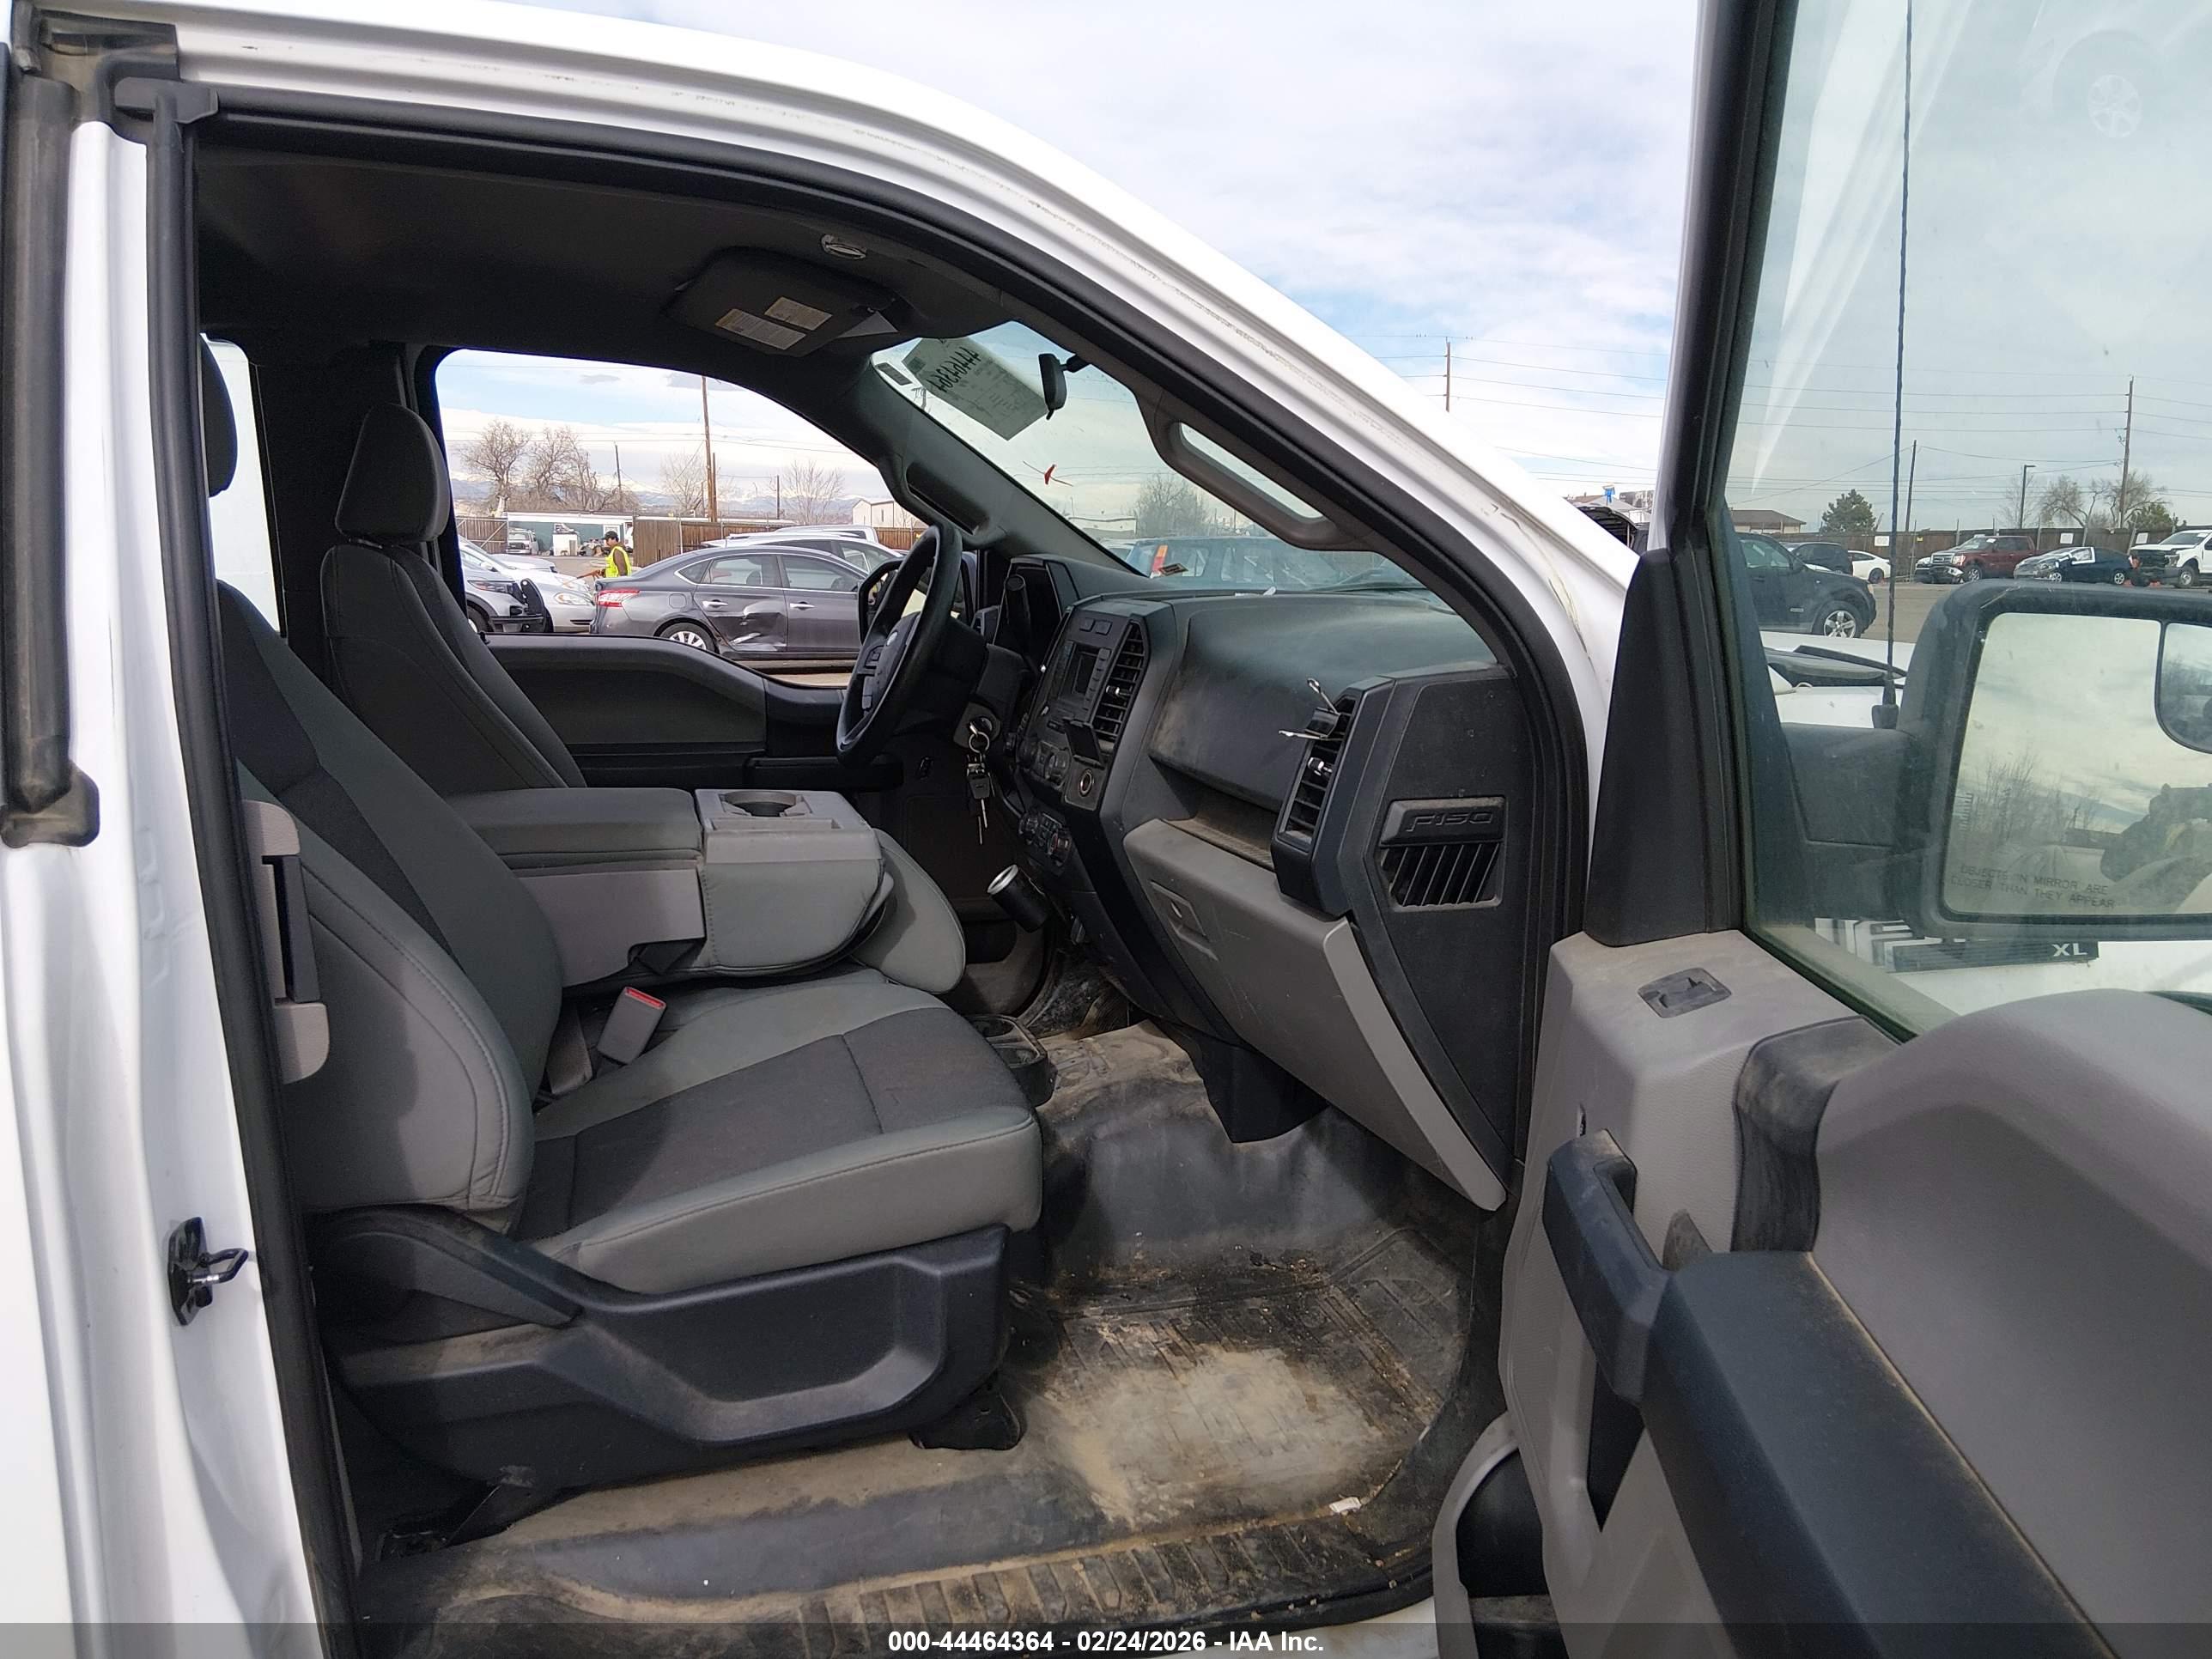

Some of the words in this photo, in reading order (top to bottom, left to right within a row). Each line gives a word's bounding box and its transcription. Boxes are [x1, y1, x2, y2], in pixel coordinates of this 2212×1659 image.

[1951, 875, 1993, 890] CLOSER
[2000, 883, 2027, 896] THAN
[2034, 888, 2062, 902] THEY
[2069, 894, 2116, 908] APPEAR
[1960, 865, 2008, 880] OBJECTS
[2033, 876, 2078, 890] MIRROR
[2087, 884, 2108, 896] ARE
[2052, 943, 2088, 957] XL
